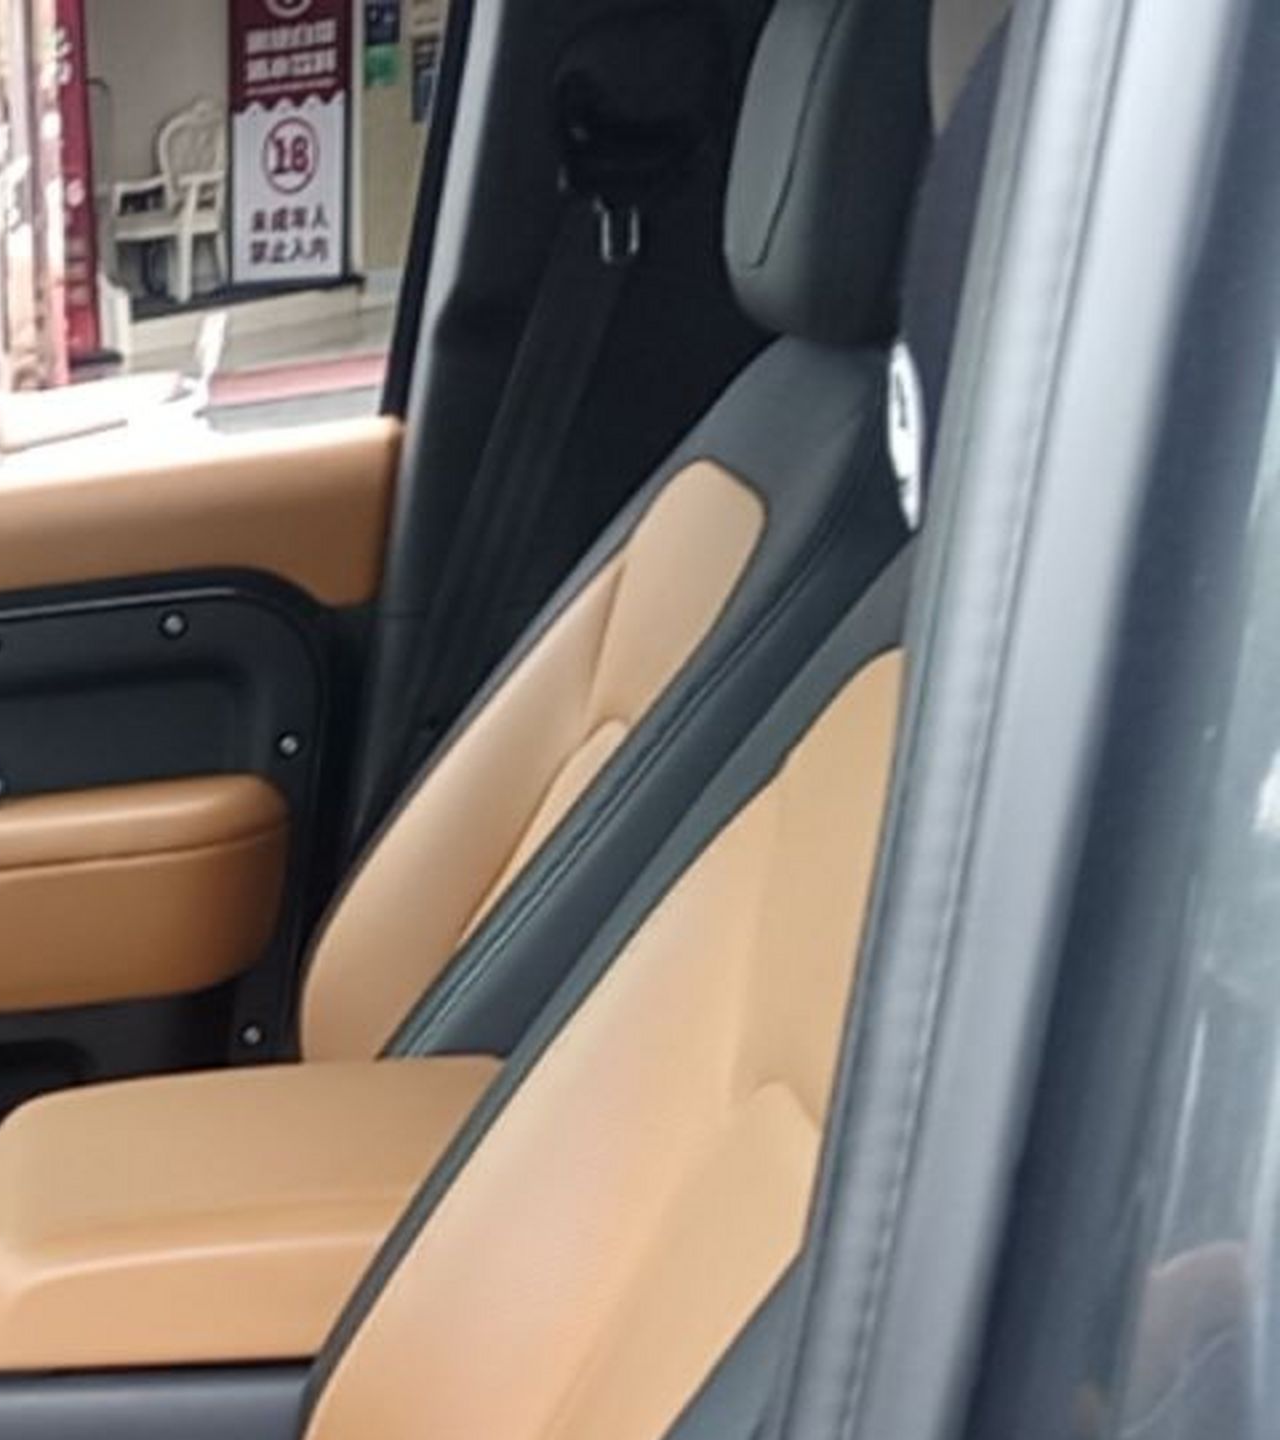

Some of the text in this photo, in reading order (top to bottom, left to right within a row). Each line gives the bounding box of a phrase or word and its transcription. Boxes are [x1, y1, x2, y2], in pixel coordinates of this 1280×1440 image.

[272, 135, 310, 175] 18
[251, 204, 330, 233] 未成年人
[250, 236, 330, 265] 禁止入内
